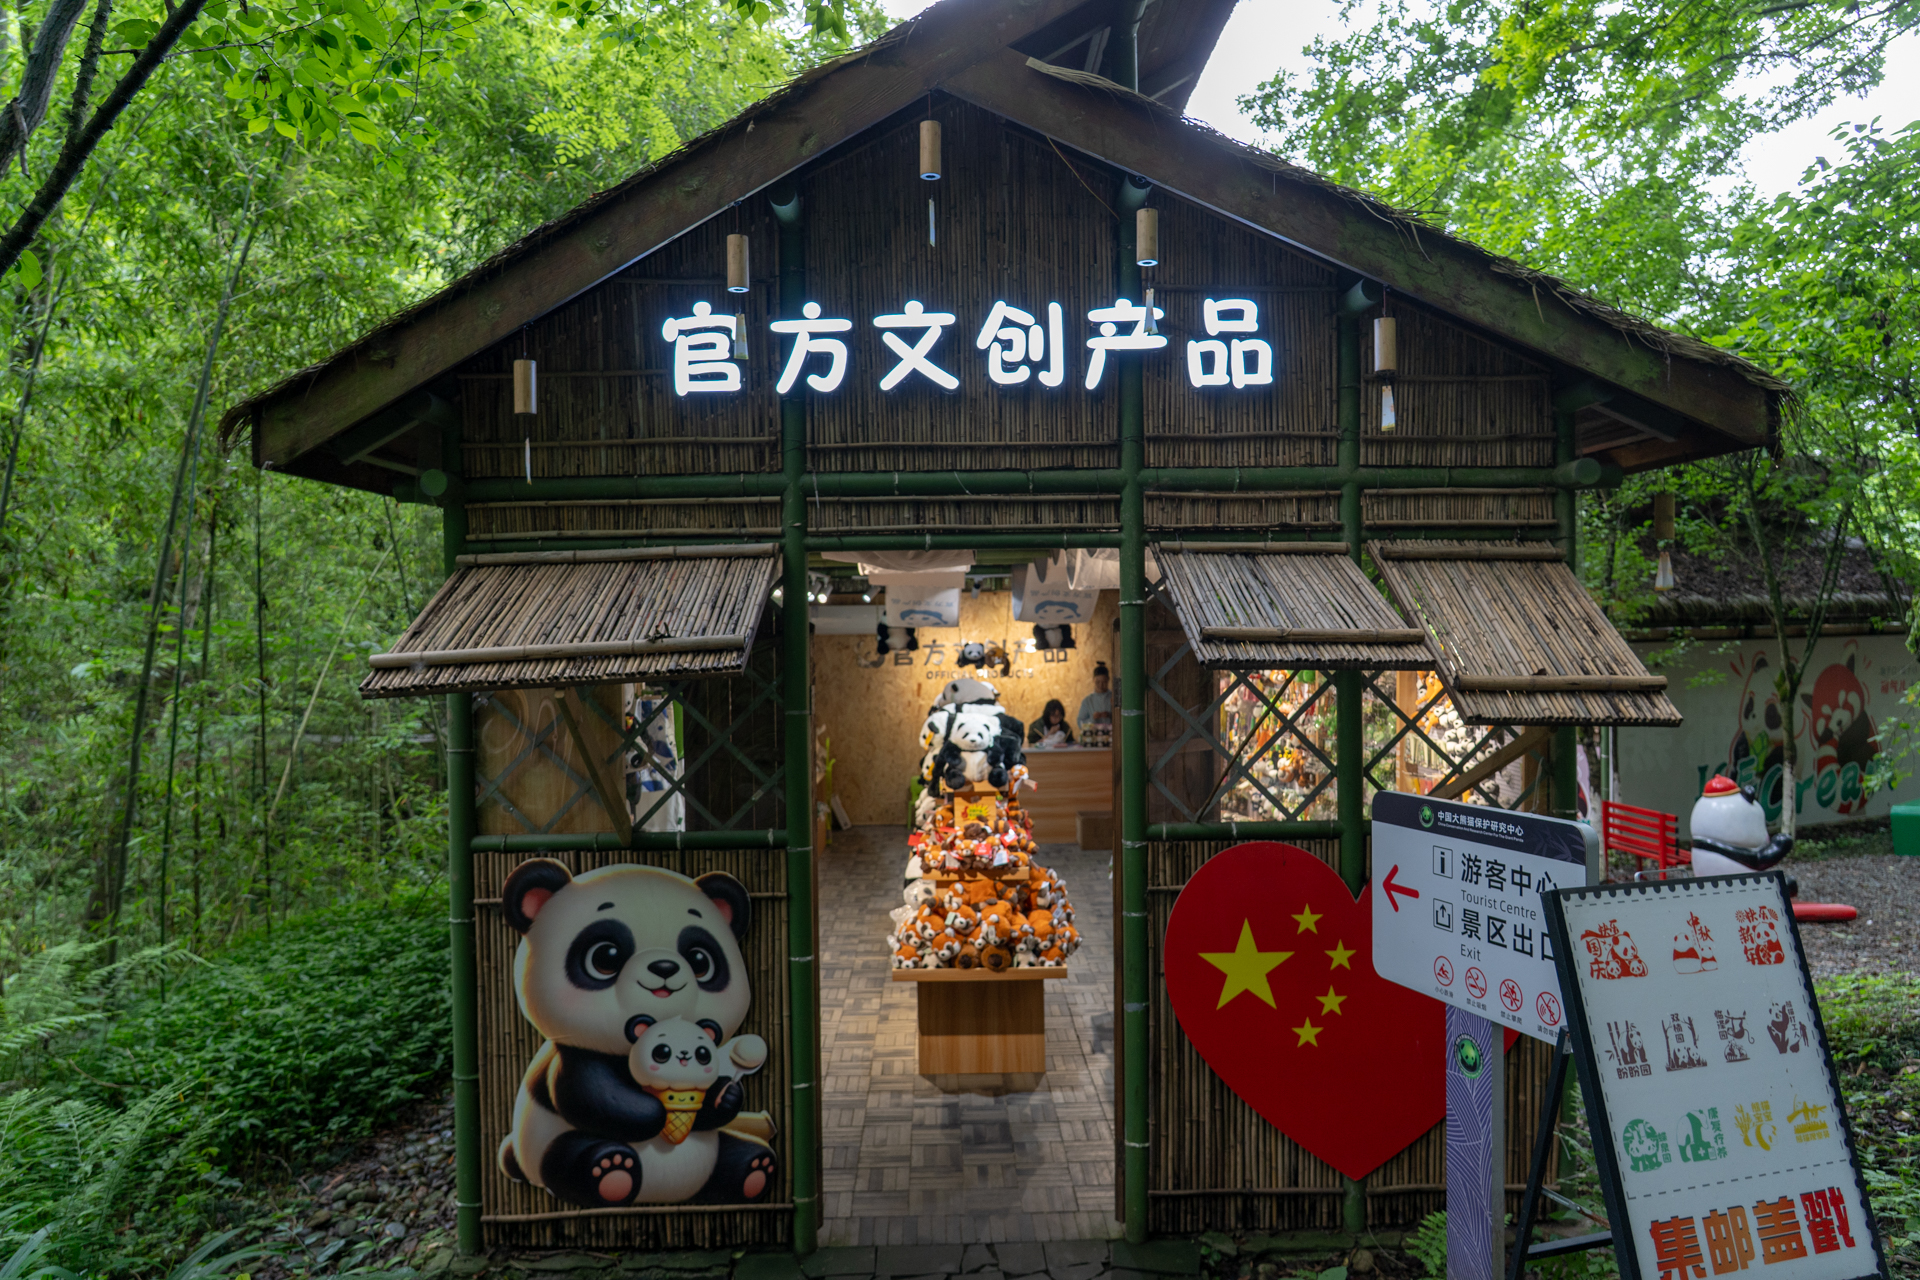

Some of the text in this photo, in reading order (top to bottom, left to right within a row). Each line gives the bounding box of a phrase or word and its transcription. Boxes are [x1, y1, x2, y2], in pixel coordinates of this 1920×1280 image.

[662, 298, 1273, 396] 官方文创产品
[926, 669, 974, 680] OFFICIAL
[1437, 810, 1524, 836] 中国大熊猫保护研究中心
[1461, 853, 1558, 897] 游客中心
[1461, 889, 1537, 921] Tourist Centre
[1745, 905, 1769, 923] 快乐
[1686, 911, 1715, 949] 中秋
[1738, 925, 1756, 966] 新年
[1461, 944, 1481, 962] Exit
[1586, 938, 1607, 980] 国庆
[1466, 998, 1487, 1012] 禁止吸烟
[1500, 1010, 1523, 1025] 禁止攀爬
[1785, 1000, 1800, 1038] 熊猫打工人
[1616, 1064, 1652, 1079] 盼盼园
[1649, 1186, 1856, 1280] 集邮盖戳
